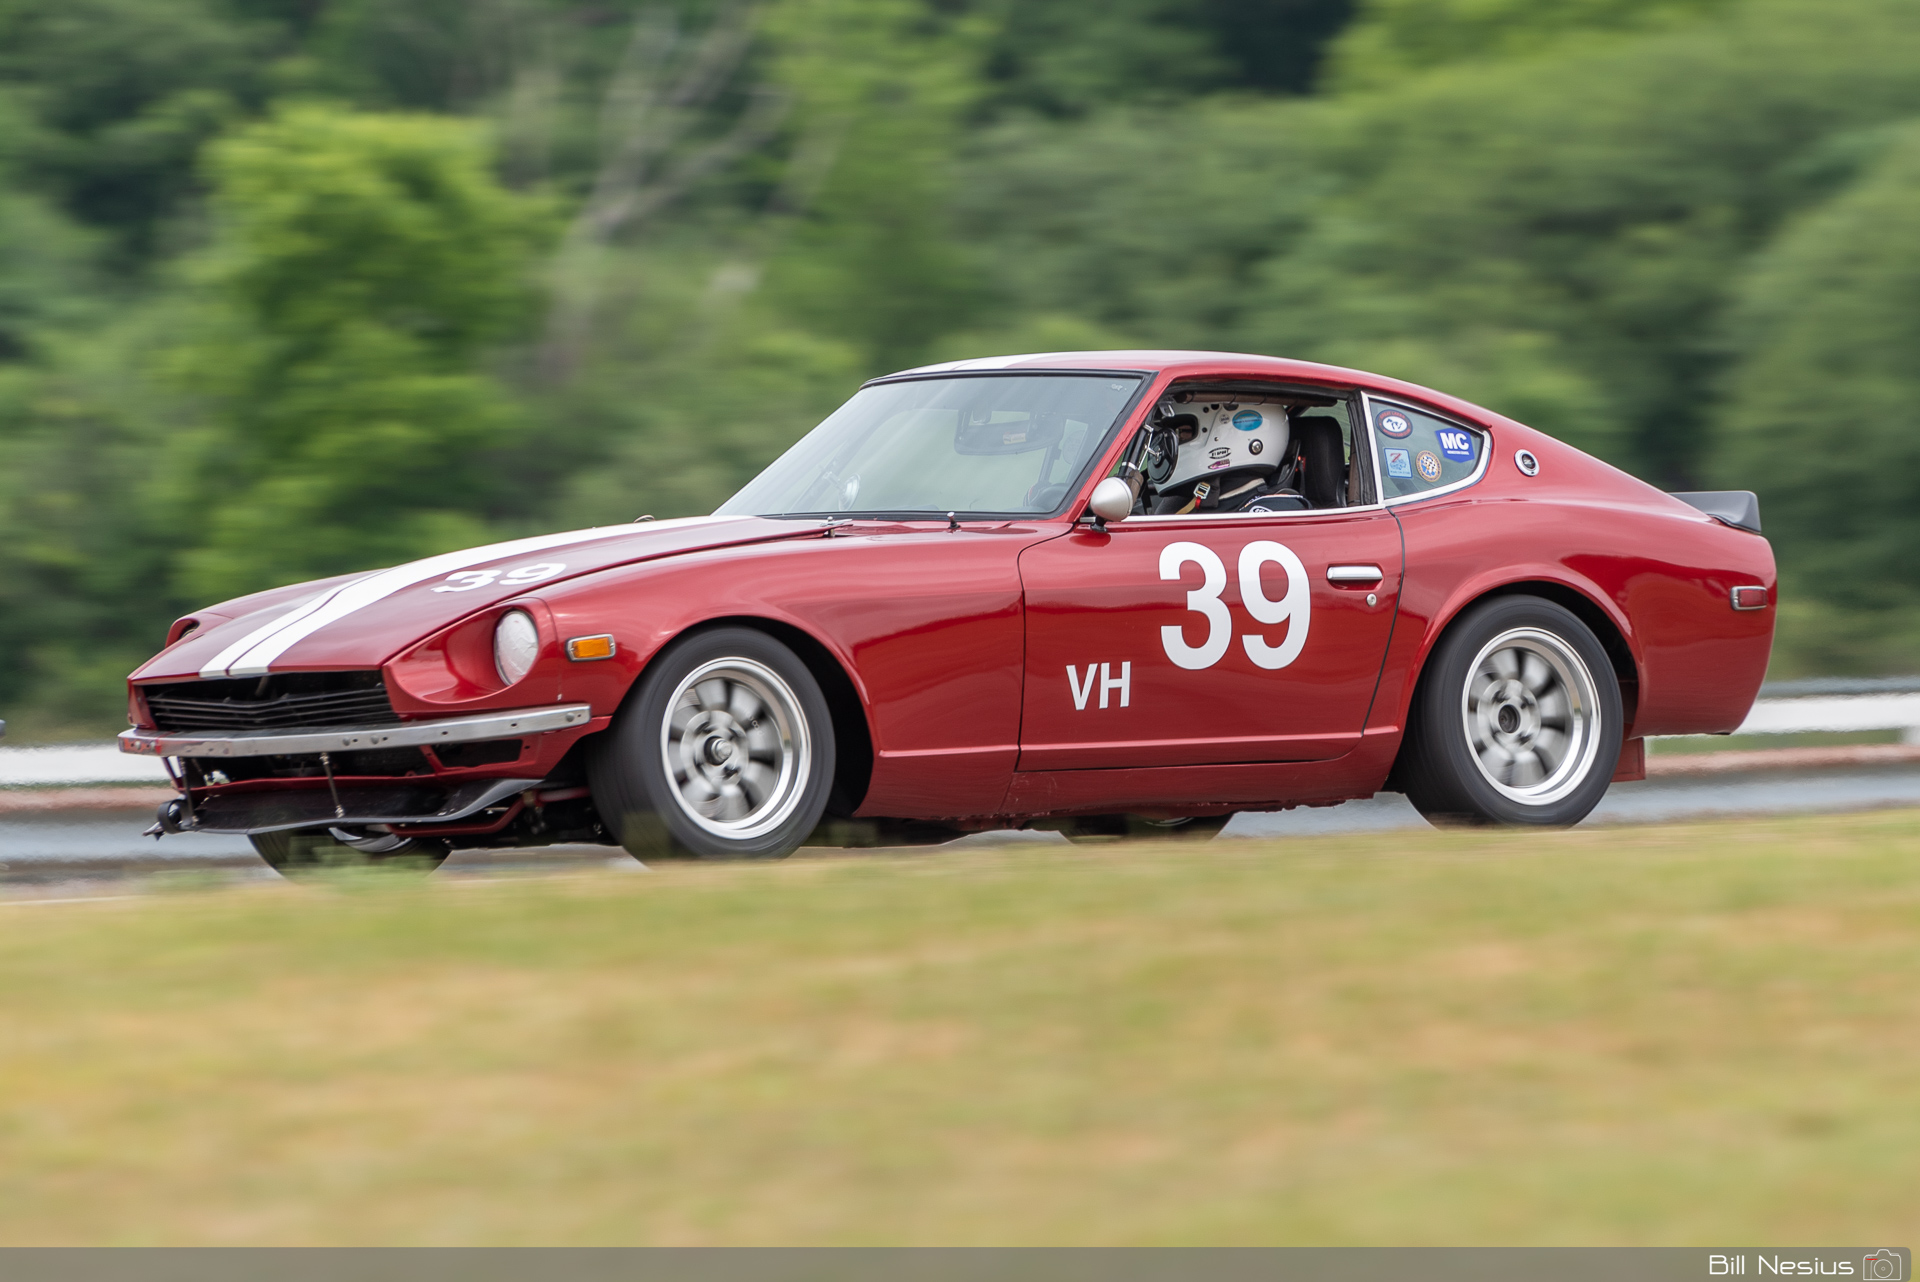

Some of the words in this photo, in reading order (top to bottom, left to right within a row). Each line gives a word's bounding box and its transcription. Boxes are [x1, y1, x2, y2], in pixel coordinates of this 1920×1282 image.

[1440, 432, 1469, 450] MC
[430, 563, 567, 593] 39
[1158, 540, 1311, 670] 39
[1065, 661, 1131, 711] VH
